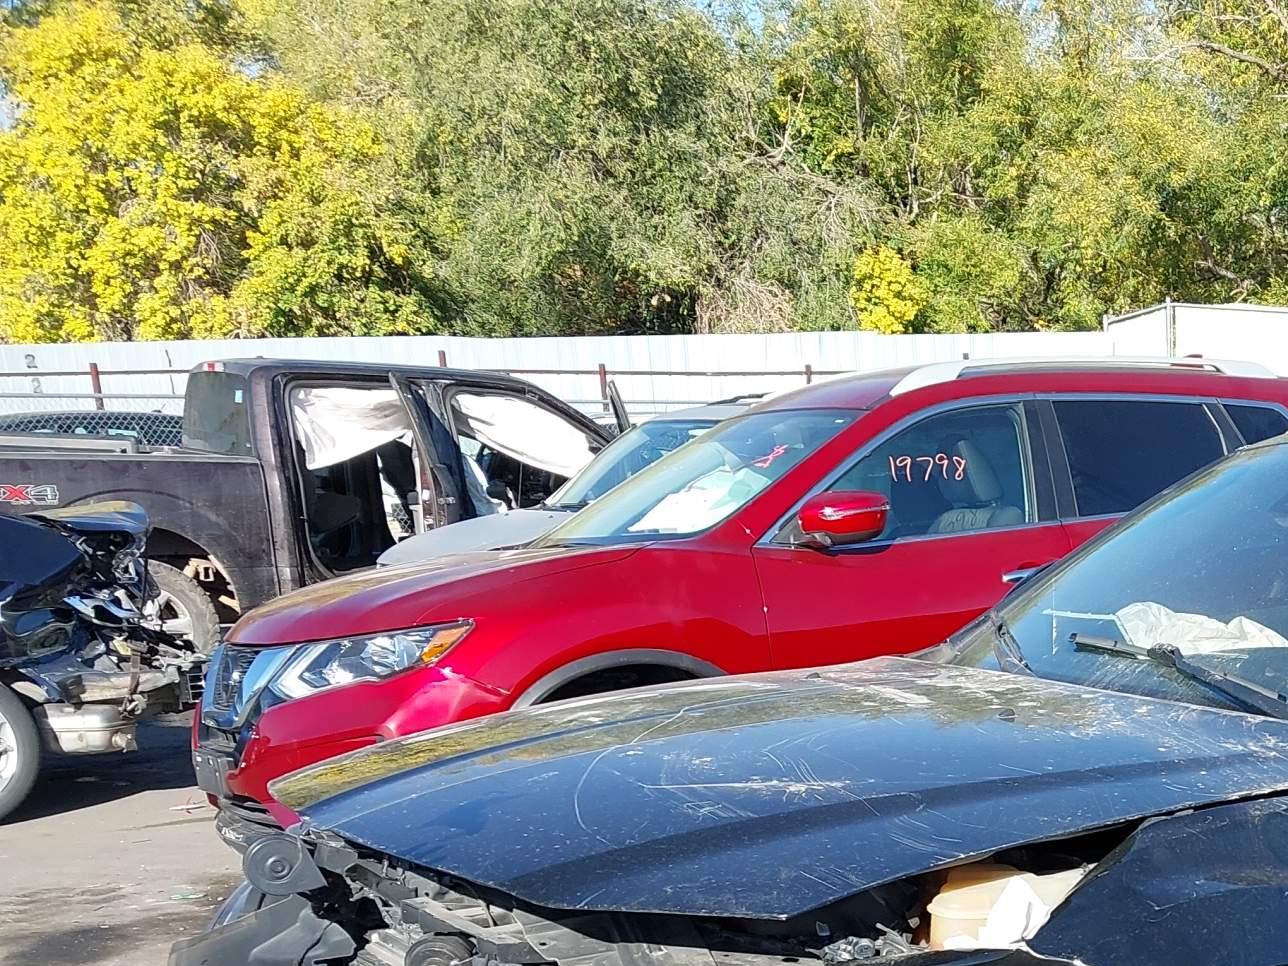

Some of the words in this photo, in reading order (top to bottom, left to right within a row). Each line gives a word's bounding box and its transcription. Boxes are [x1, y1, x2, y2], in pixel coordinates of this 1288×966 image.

[24, 353, 38, 369] 2
[888, 453, 967, 482] 19798
[0, 484, 59, 505] X4
